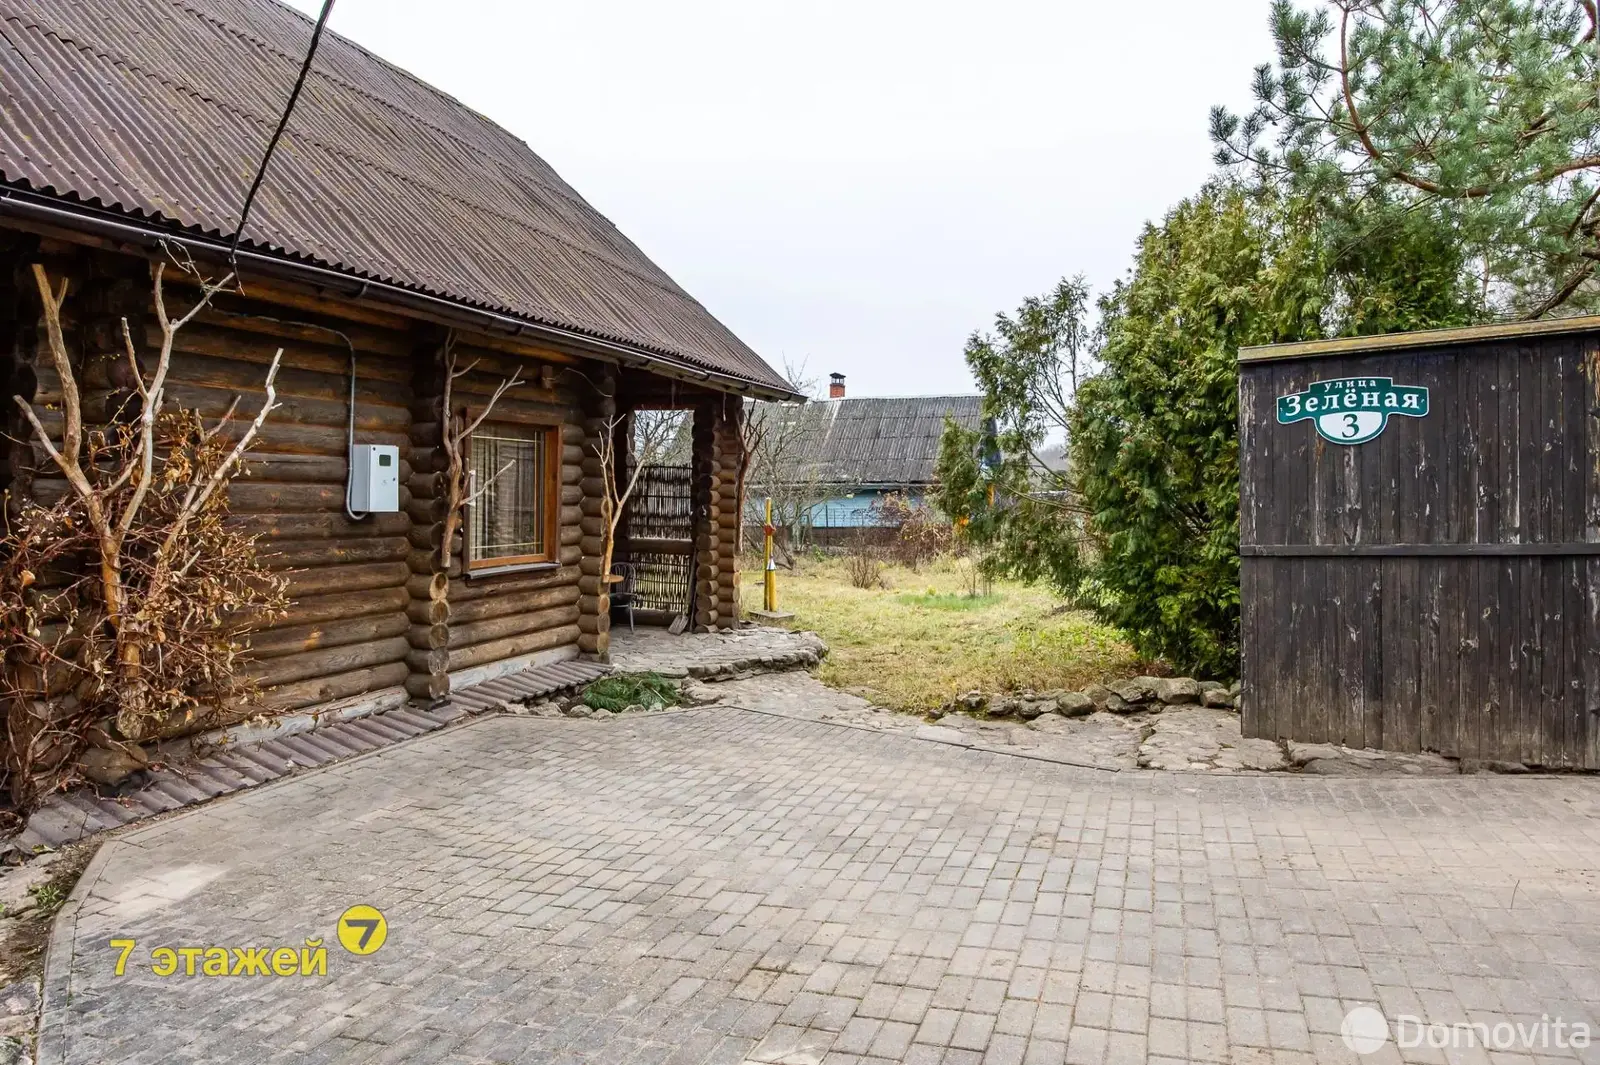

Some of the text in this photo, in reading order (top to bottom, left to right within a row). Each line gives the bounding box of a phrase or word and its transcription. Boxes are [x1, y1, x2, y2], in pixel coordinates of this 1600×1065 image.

[1324, 379, 1377, 392] улица
[1285, 389, 1421, 416] Зелёная
[1341, 413, 1360, 438] 3
